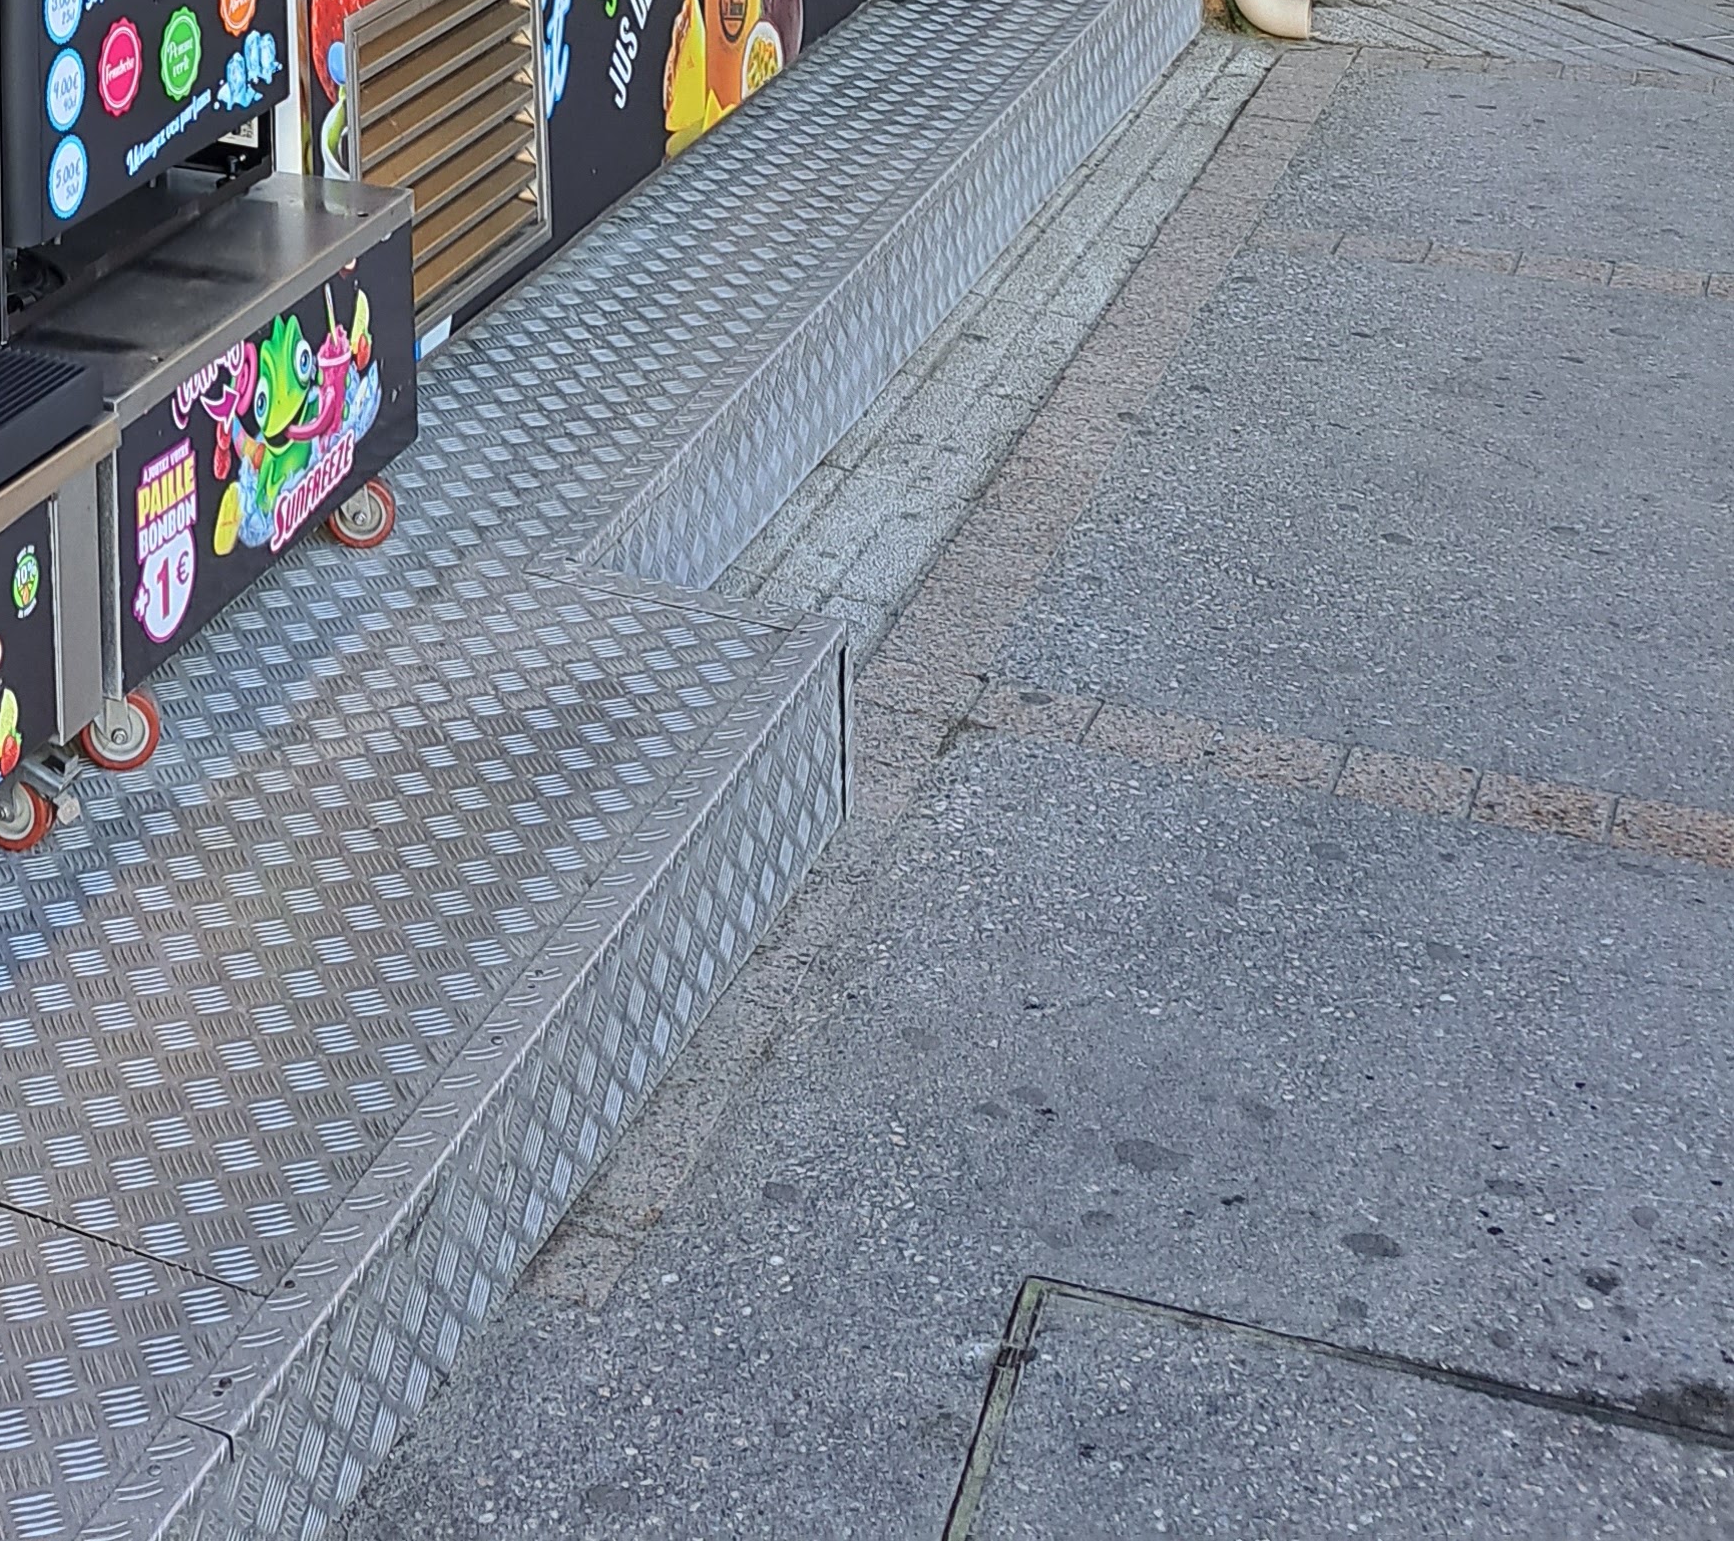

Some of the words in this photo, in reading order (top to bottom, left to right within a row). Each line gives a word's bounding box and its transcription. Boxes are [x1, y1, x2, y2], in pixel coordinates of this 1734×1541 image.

[608, 15, 640, 111] JUS
[179, 88, 212, 133] parfums
[138, 452, 196, 529] PAILLE
[170, 441, 191, 467] VOTRE
[271, 428, 355, 553] SUNFREEZE
[138, 492, 197, 564] BONBON
